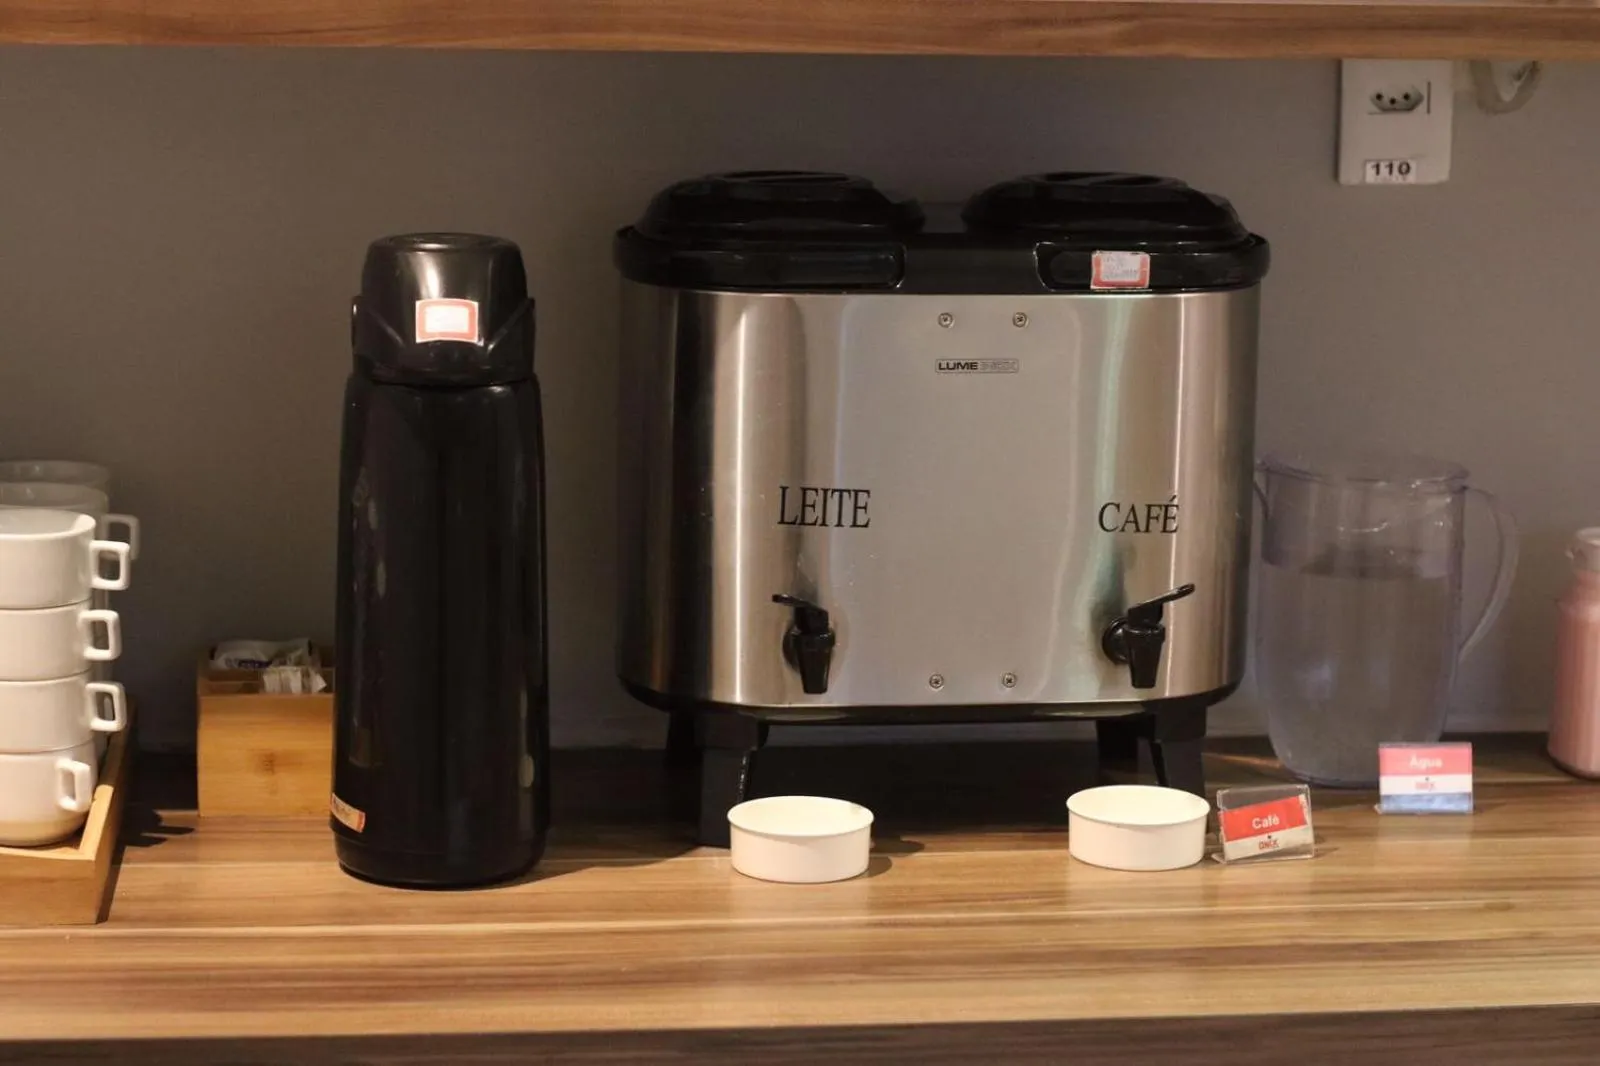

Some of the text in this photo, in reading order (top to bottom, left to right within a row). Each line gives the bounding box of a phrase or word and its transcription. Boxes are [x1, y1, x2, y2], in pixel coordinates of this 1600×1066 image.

[1371, 161, 1411, 176] 110
[777, 486, 871, 528] LEITE
[1098, 494, 1179, 533] CAFÉ
[1251, 813, 1280, 830] Café
